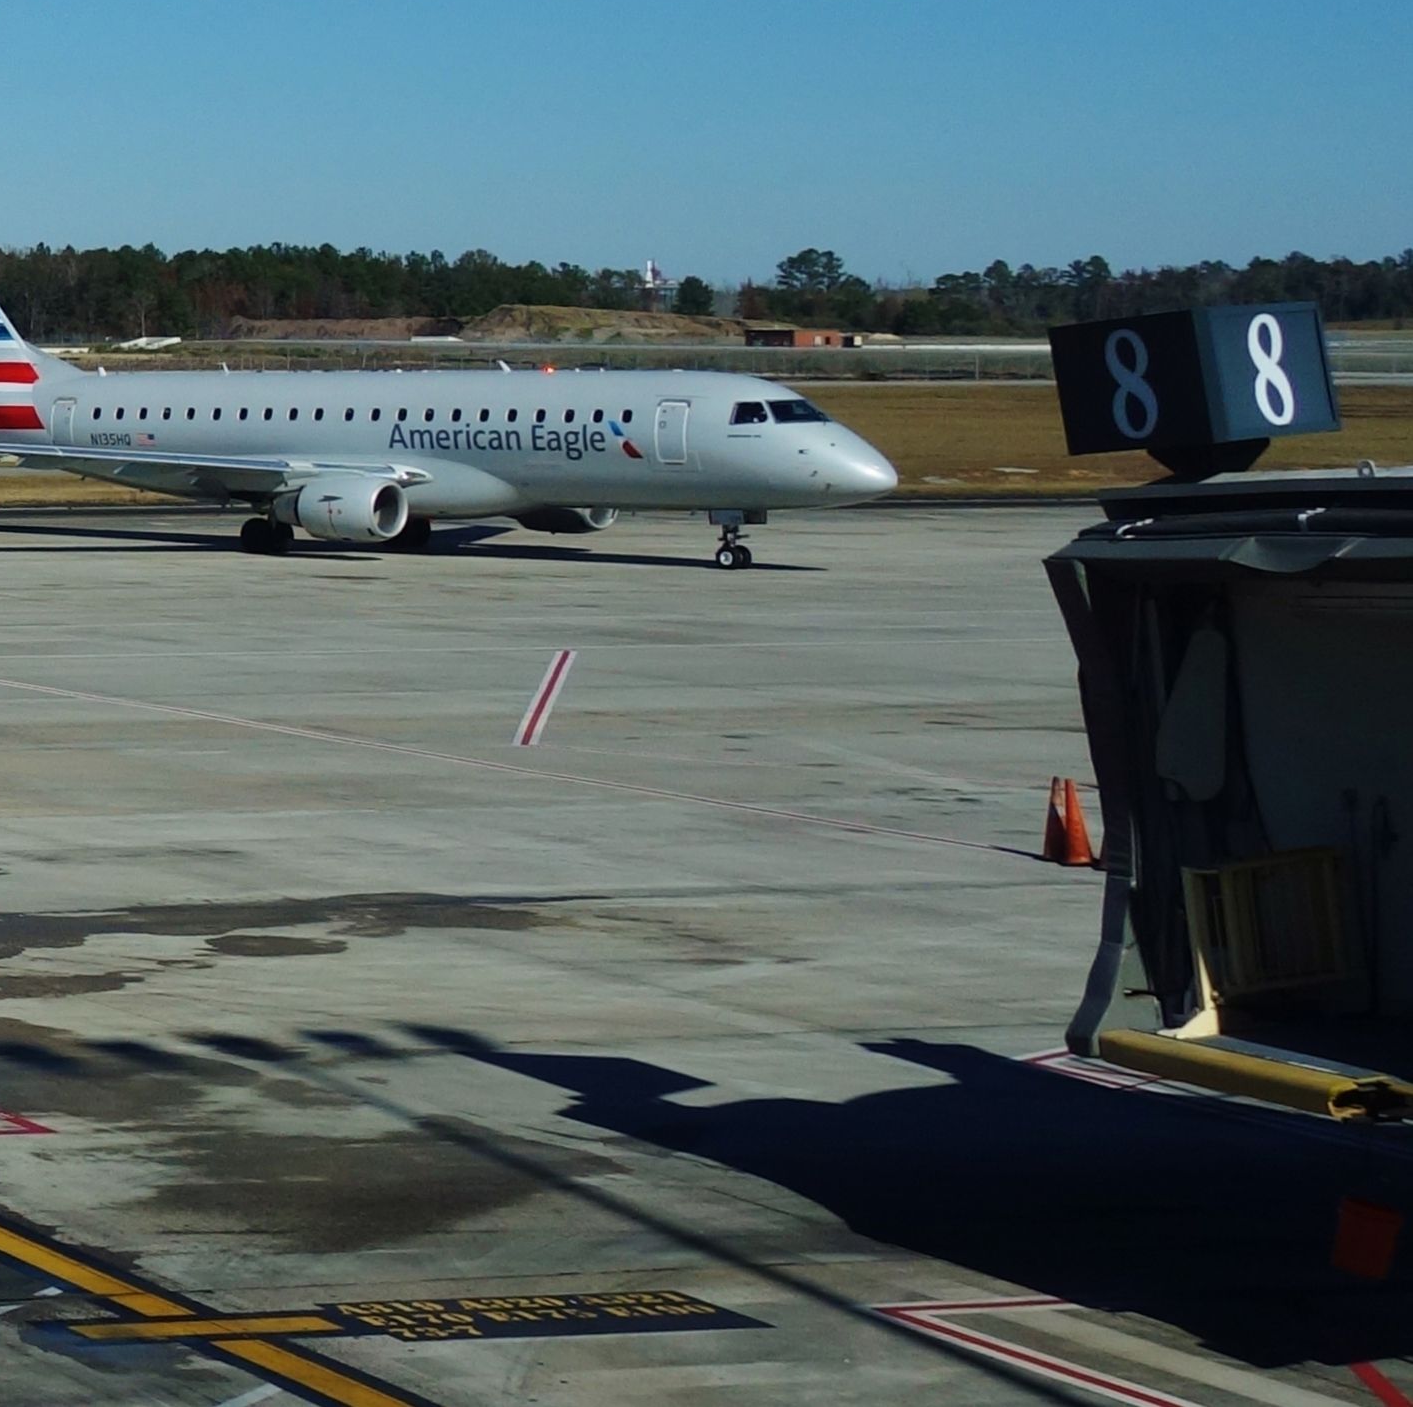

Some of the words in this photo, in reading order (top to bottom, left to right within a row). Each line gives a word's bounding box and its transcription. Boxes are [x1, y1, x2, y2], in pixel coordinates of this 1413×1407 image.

[1104, 328, 1158, 439] 8
[1247, 313, 1294, 425] 8
[90, 433, 131, 445] N135HQ
[388, 423, 522, 450] American
[531, 424, 606, 460] Eagle
